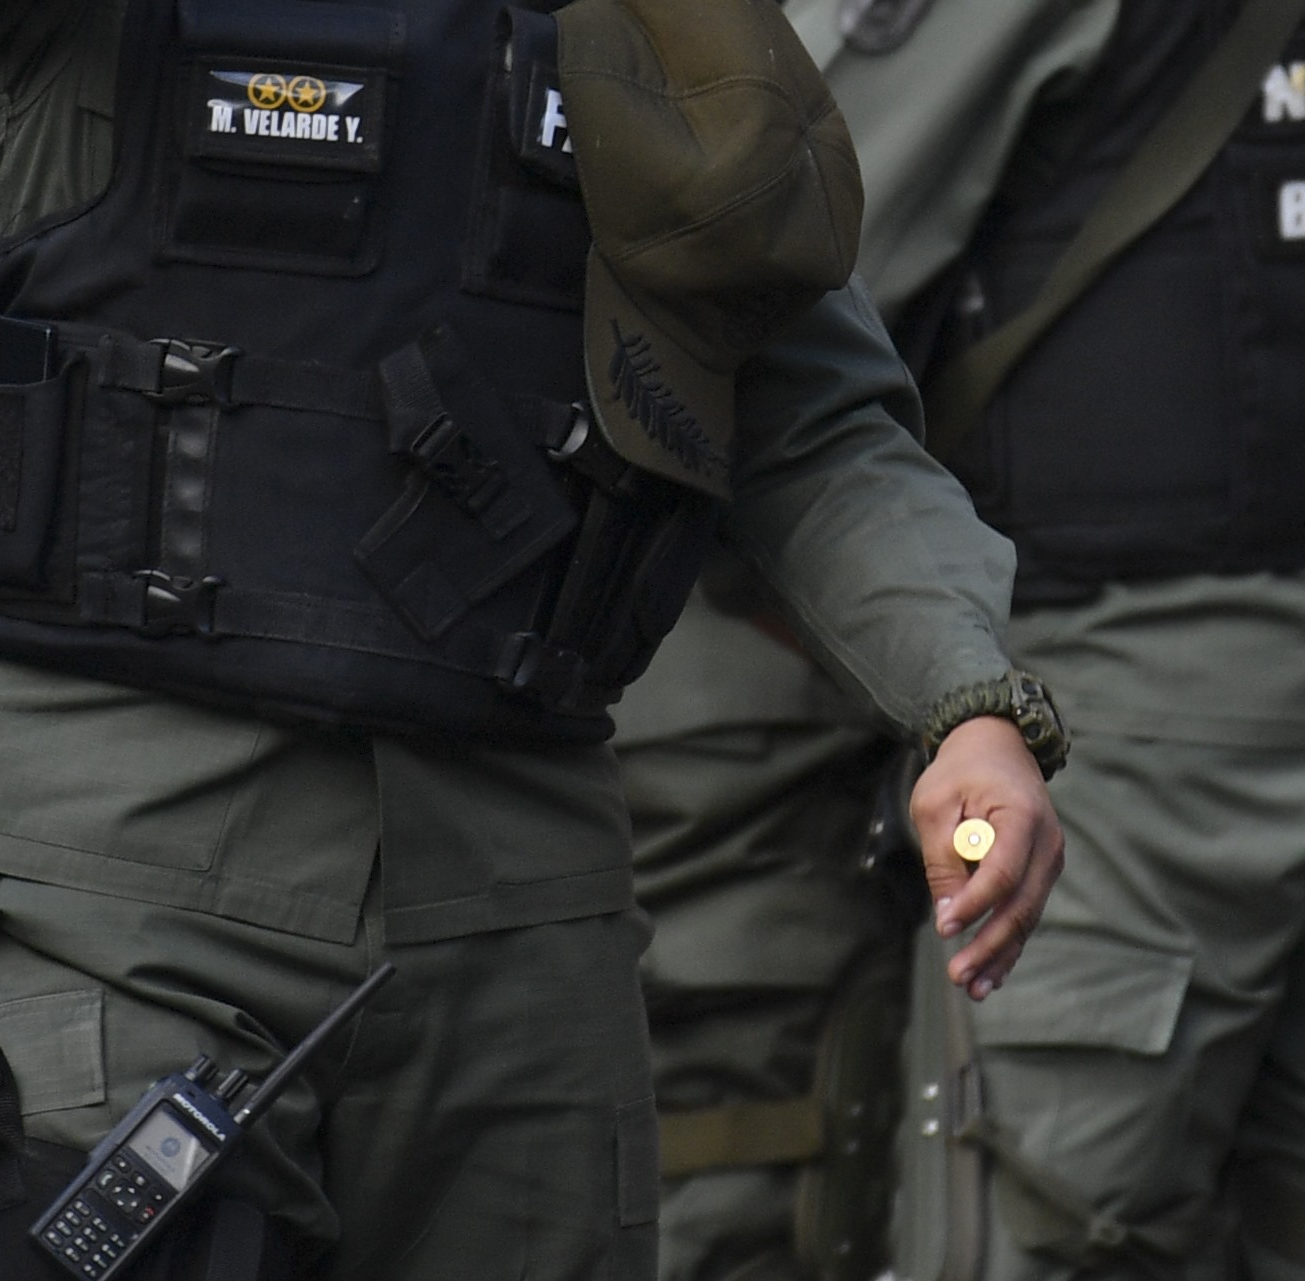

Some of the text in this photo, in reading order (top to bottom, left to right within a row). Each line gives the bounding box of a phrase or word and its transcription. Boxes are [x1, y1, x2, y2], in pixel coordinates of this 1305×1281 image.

[209, 103, 364, 145] M. VELARDE Y.
[172, 1092, 227, 1142] MOTOROLA
